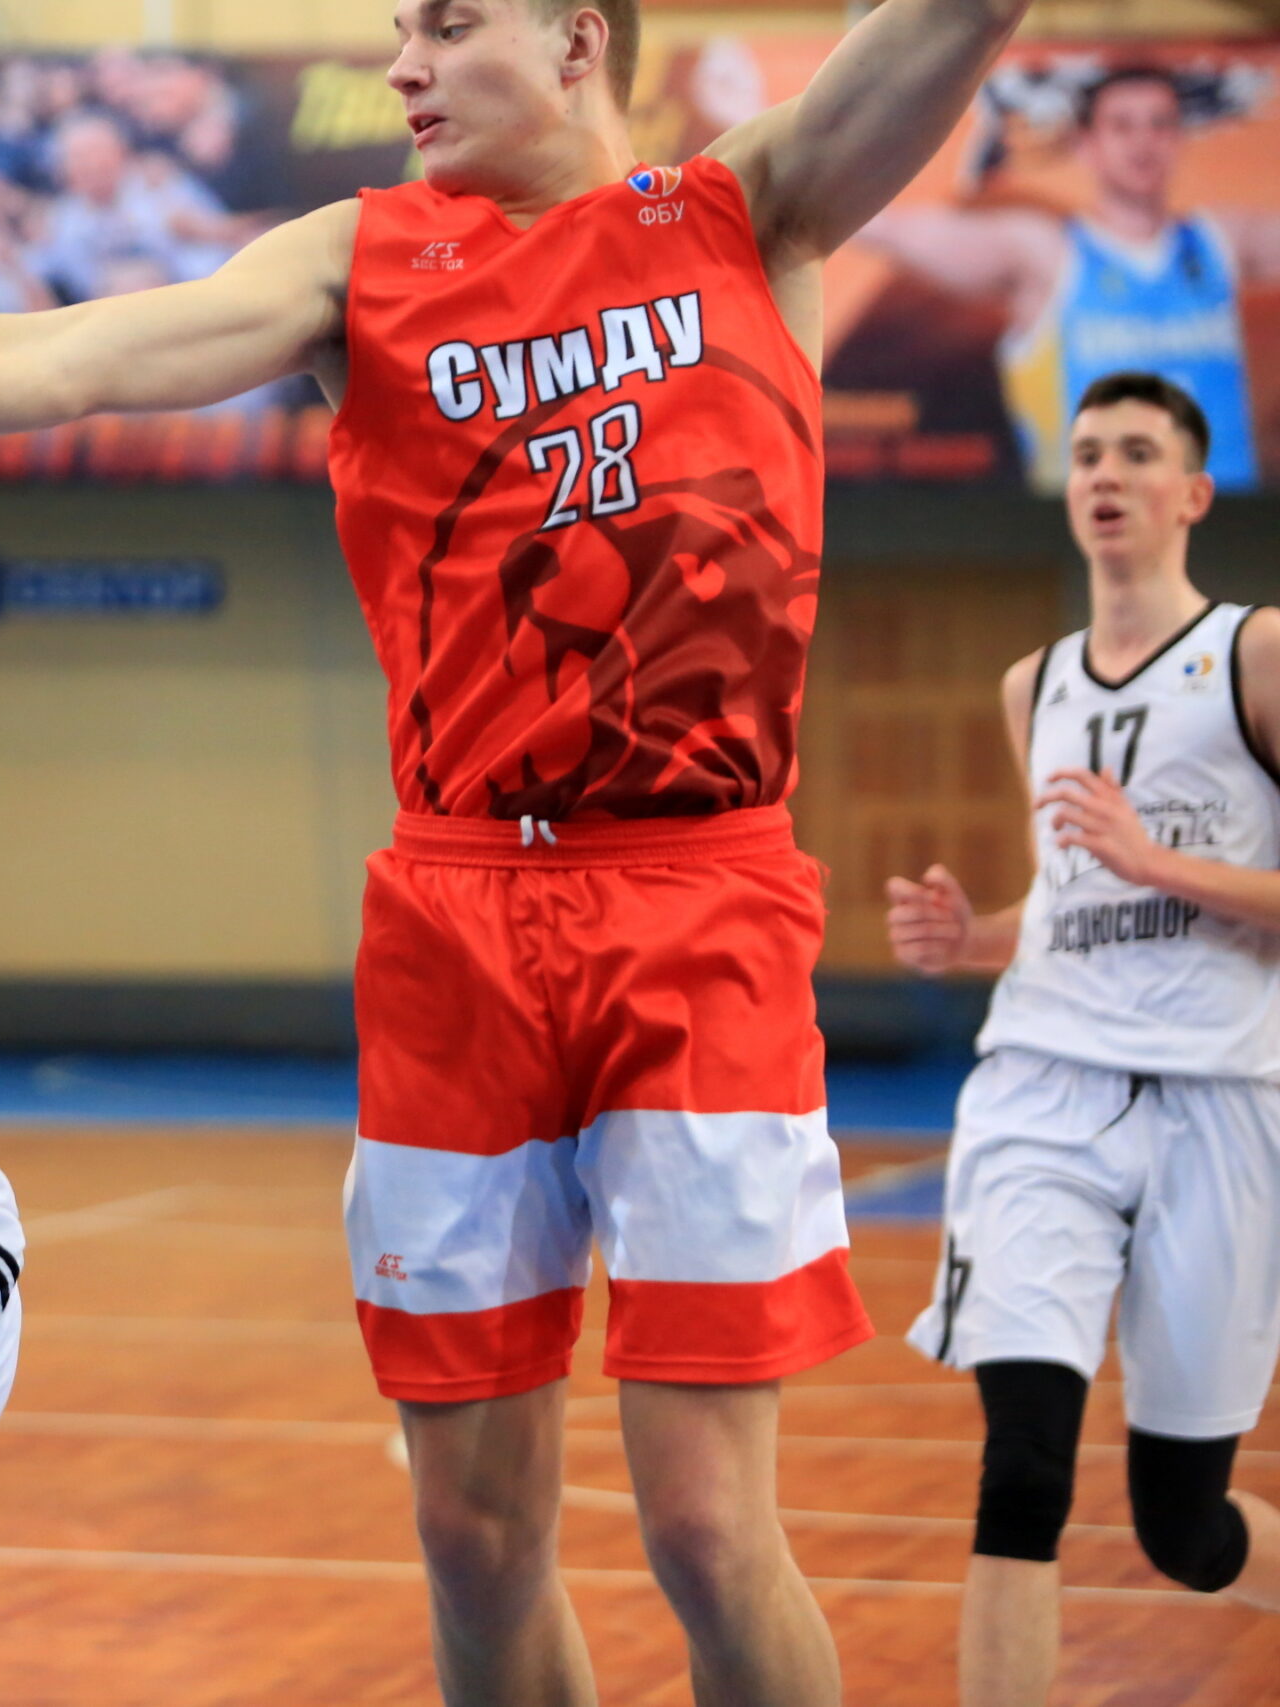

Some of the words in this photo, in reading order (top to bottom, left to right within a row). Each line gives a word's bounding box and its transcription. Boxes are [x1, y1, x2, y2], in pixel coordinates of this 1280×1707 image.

[638, 200, 685, 226] ФБУ
[524, 400, 641, 532] 28
[1086, 703, 1150, 787] 17
